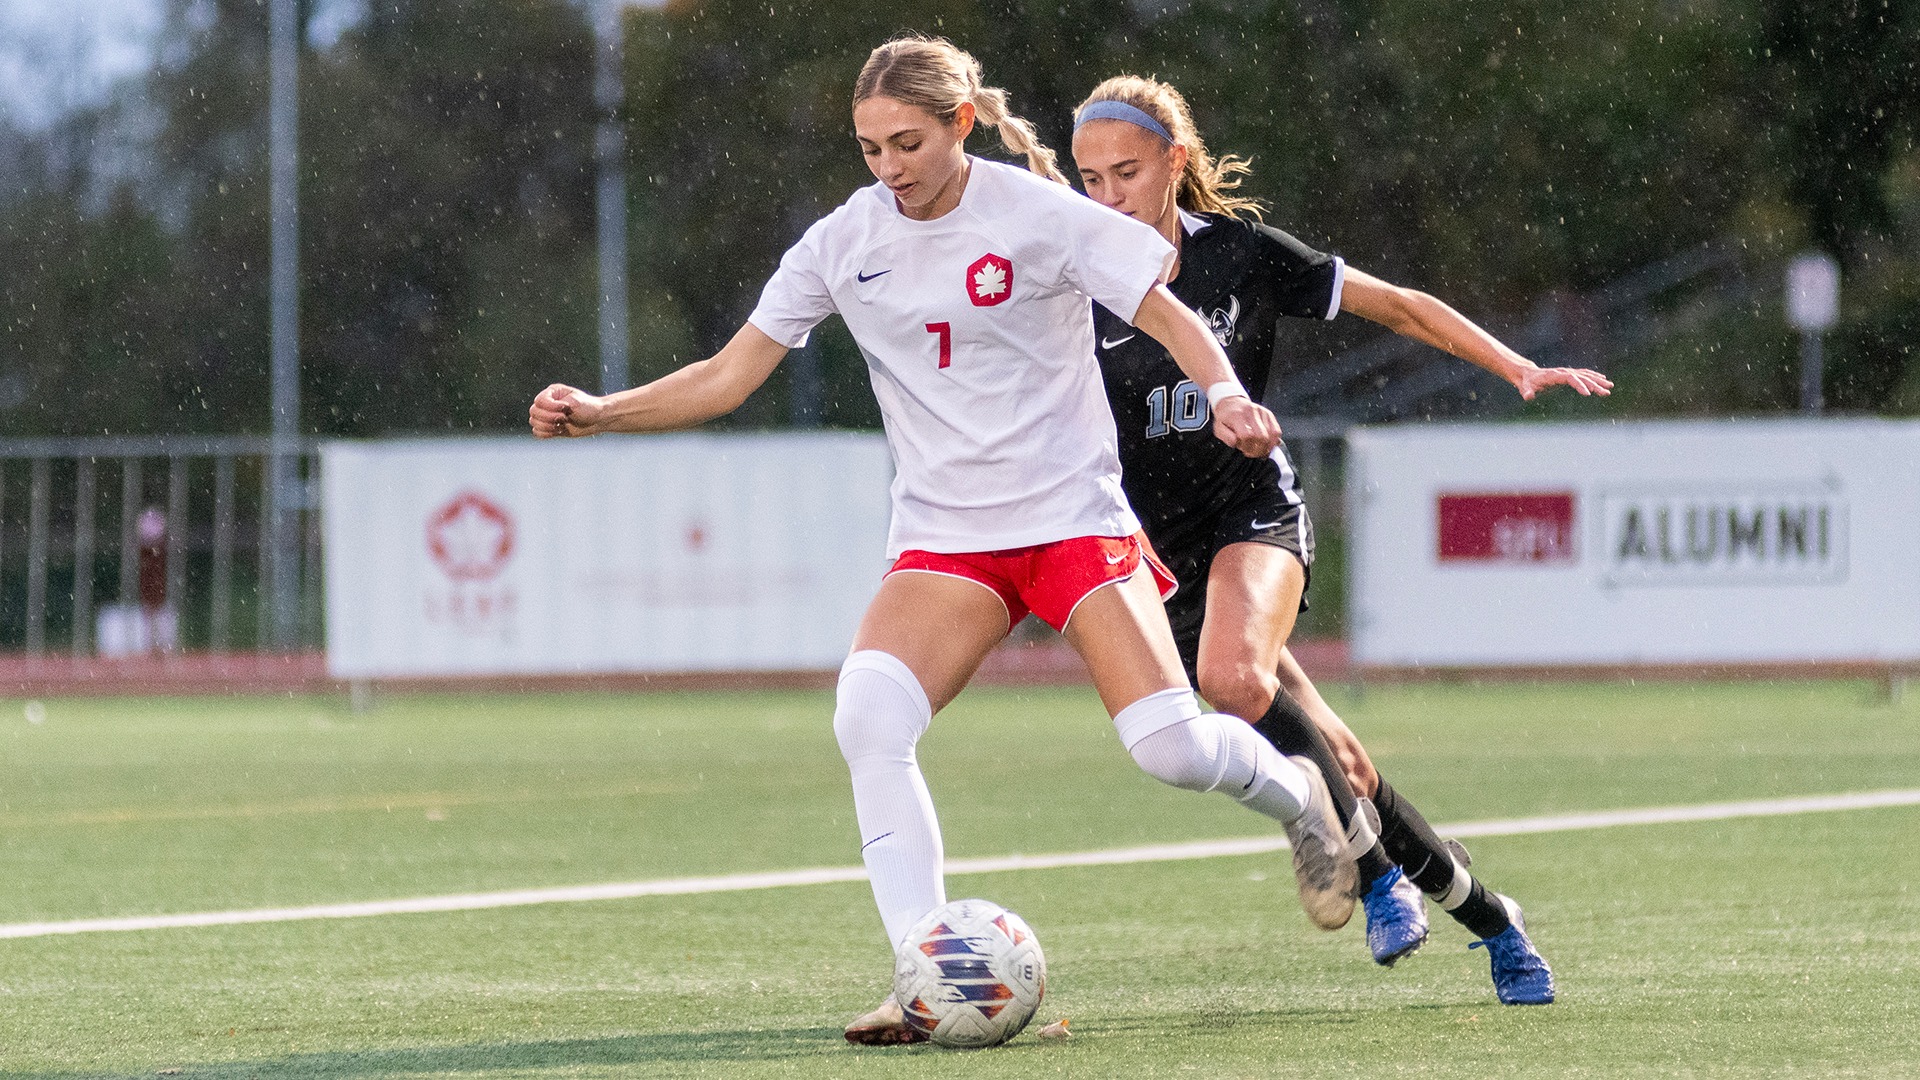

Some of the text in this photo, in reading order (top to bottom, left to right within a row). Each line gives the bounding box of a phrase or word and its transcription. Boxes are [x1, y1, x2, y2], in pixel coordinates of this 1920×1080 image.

[925, 321, 951, 370] 7
[1146, 380, 1210, 440] 10
[1616, 504, 1830, 562] ALUMNI
